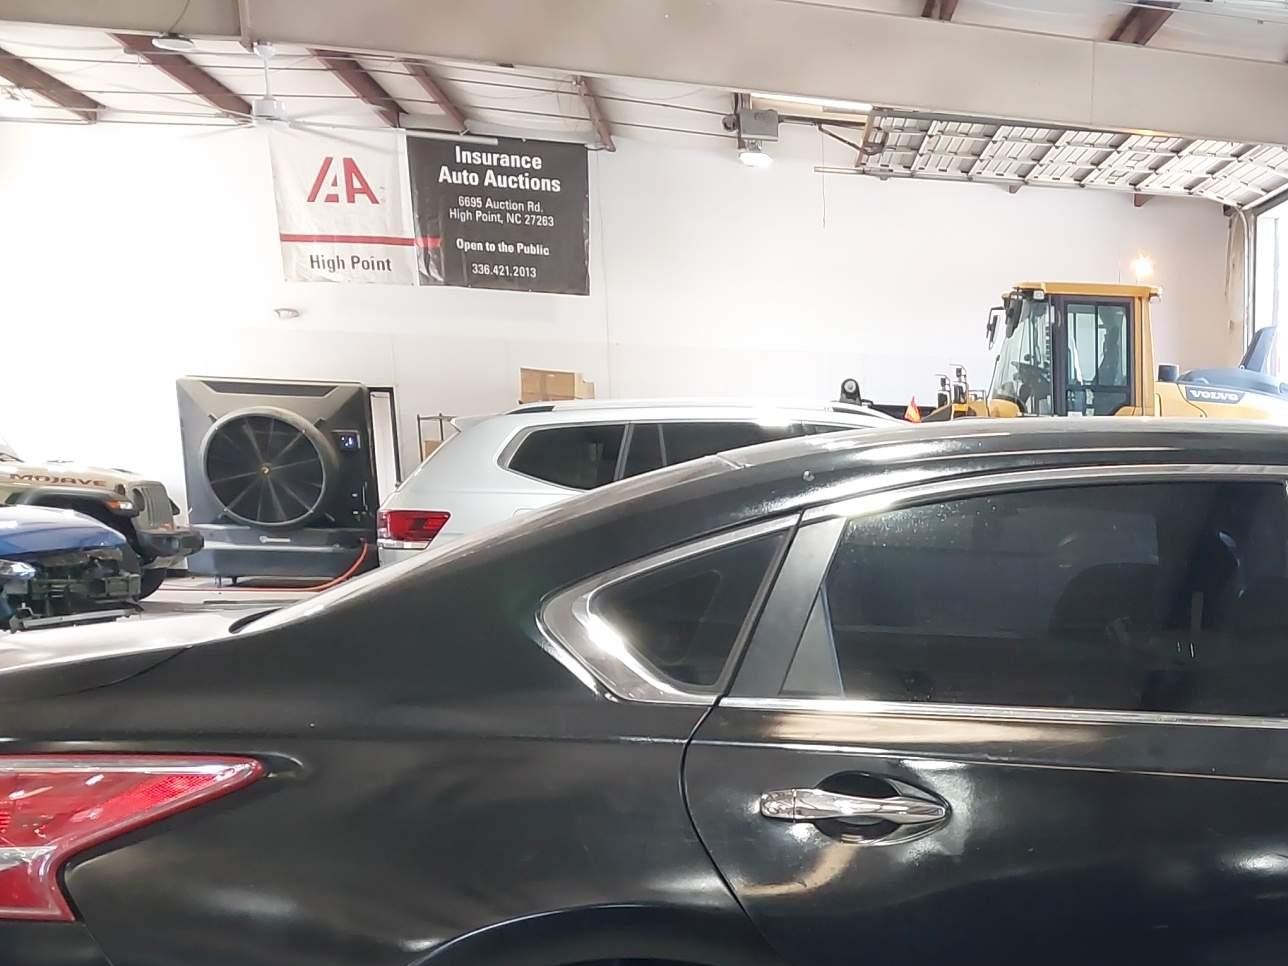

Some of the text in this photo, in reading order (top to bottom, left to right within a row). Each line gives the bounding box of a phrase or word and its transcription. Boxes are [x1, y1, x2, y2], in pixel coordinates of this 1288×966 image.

[455, 145, 542, 170] Insurance
[438, 165, 561, 192] Auto Auctions
[458, 195, 544, 213] 6695 Auction Rd.
[449, 207, 554, 227] High Point, NC 27263
[456, 238, 550, 256] Open to the Public
[309, 254, 392, 273] High Point
[471, 263, 537, 278] 336.421.2013
[1189, 390, 1239, 400] VOLVO
[10, 473, 106, 487] MOJAVE
